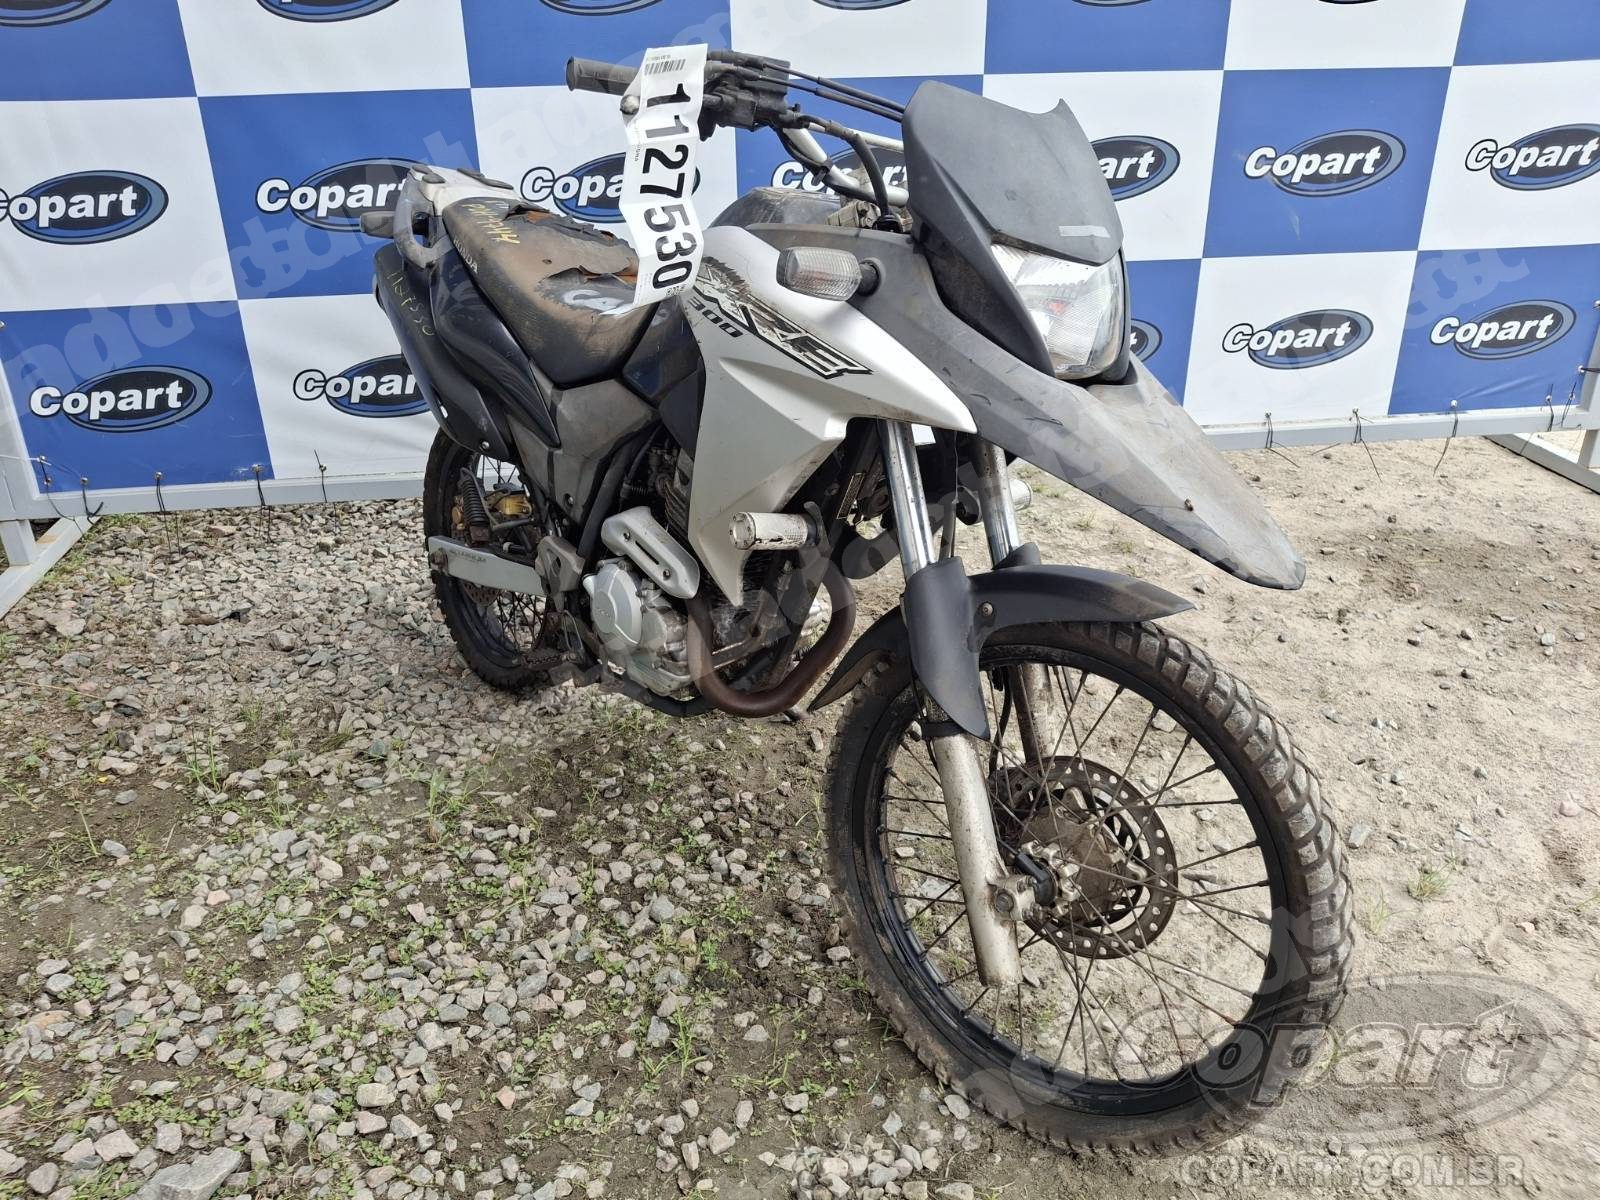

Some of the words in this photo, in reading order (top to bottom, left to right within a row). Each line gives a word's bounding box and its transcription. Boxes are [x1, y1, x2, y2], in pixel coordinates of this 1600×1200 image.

[1244, 146, 1381, 183] Copart
[1465, 138, 1600, 175] Copart
[640, 83, 698, 289] 1127530
[453, 237, 479, 275] HONDA
[687, 295, 743, 338] 300
[1430, 313, 1554, 349] Copart
[1222, 322, 1351, 356] Copart
[30, 380, 183, 421] Copart
